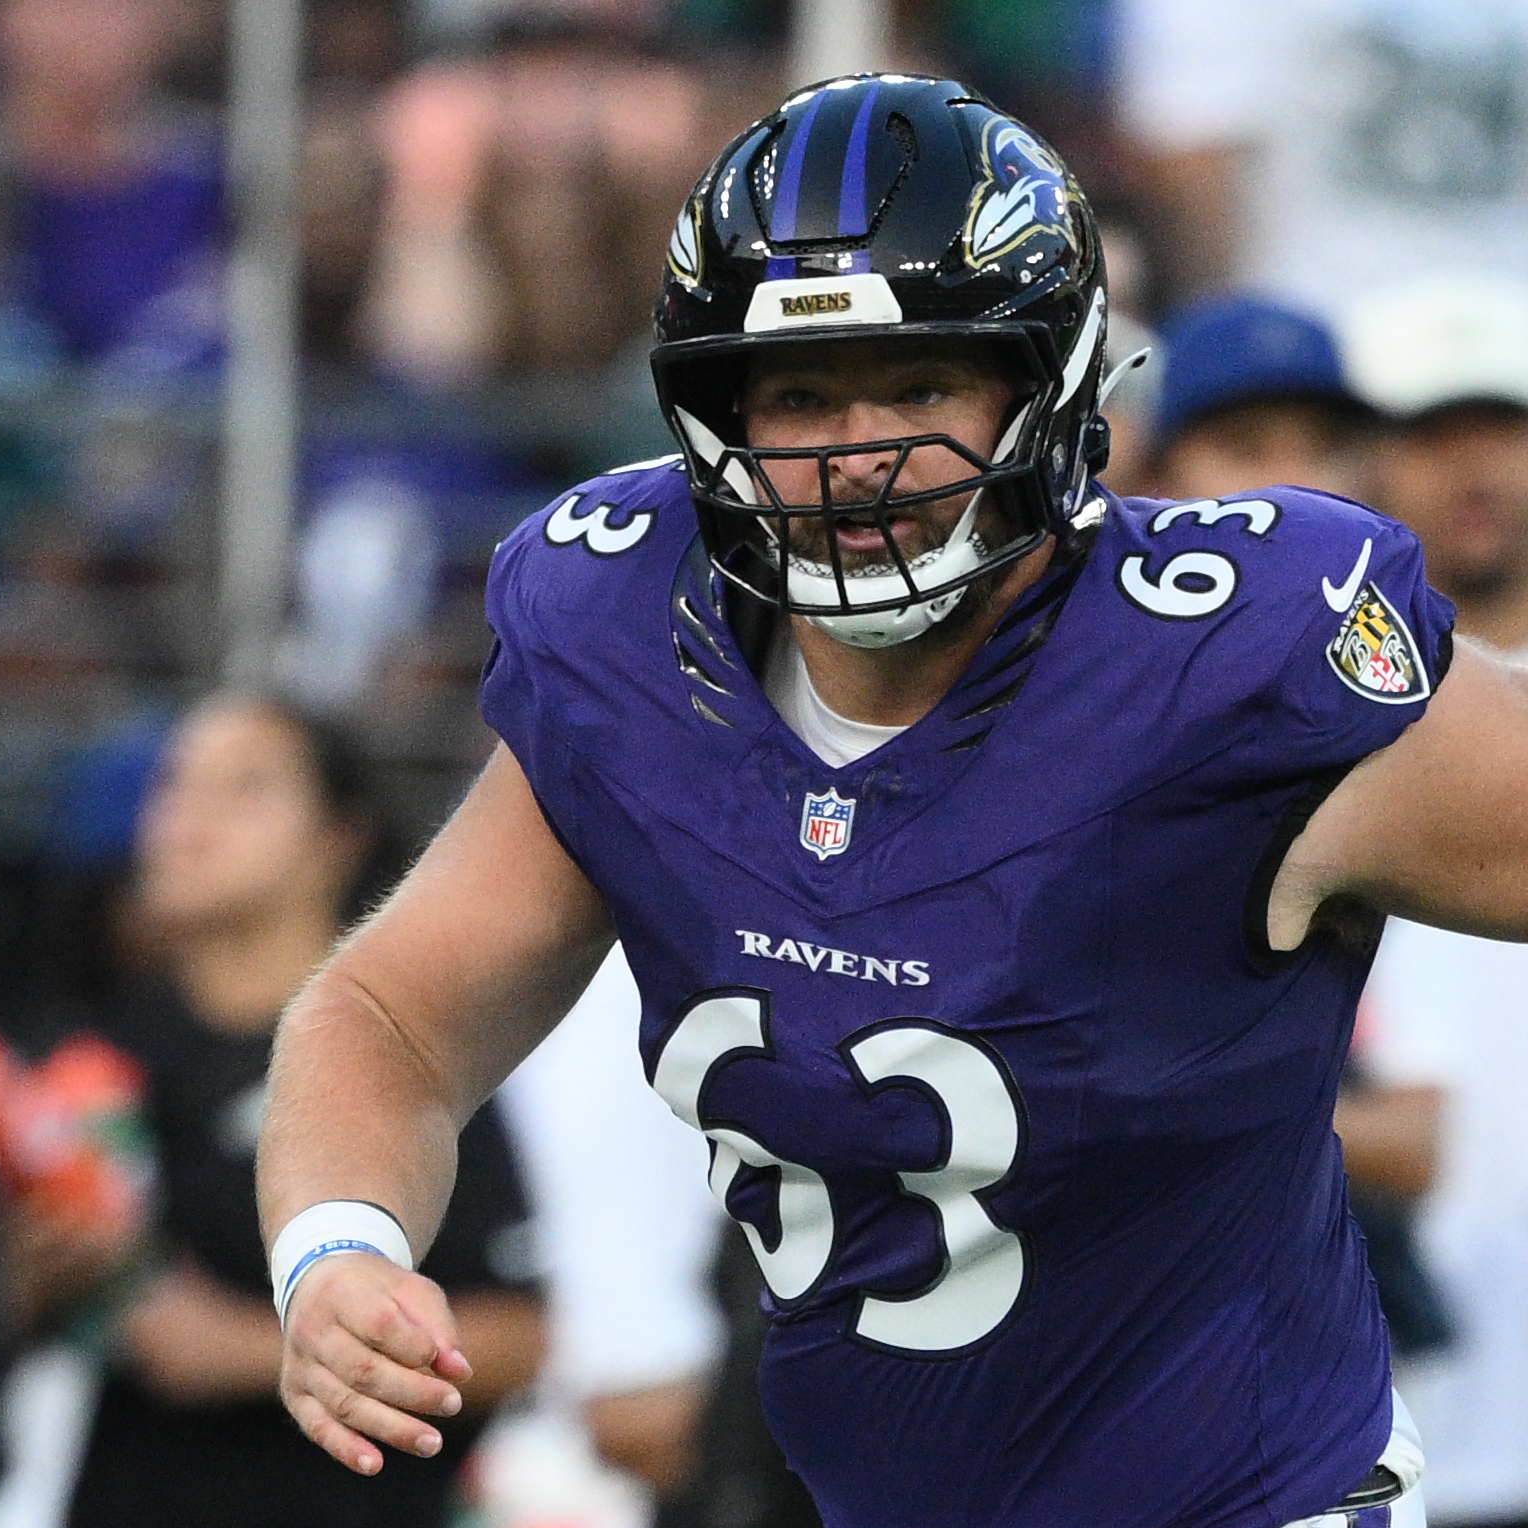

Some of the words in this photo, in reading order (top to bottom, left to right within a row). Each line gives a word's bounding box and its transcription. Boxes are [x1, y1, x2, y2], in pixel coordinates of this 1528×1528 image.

[780, 292, 852, 316] RAVENS
[1118, 499, 1280, 620] 63
[1332, 589, 1369, 653] RAVENS
[809, 819, 842, 846] NFL
[735, 930, 930, 986] RAVENS
[650, 988, 1030, 1357] 63
